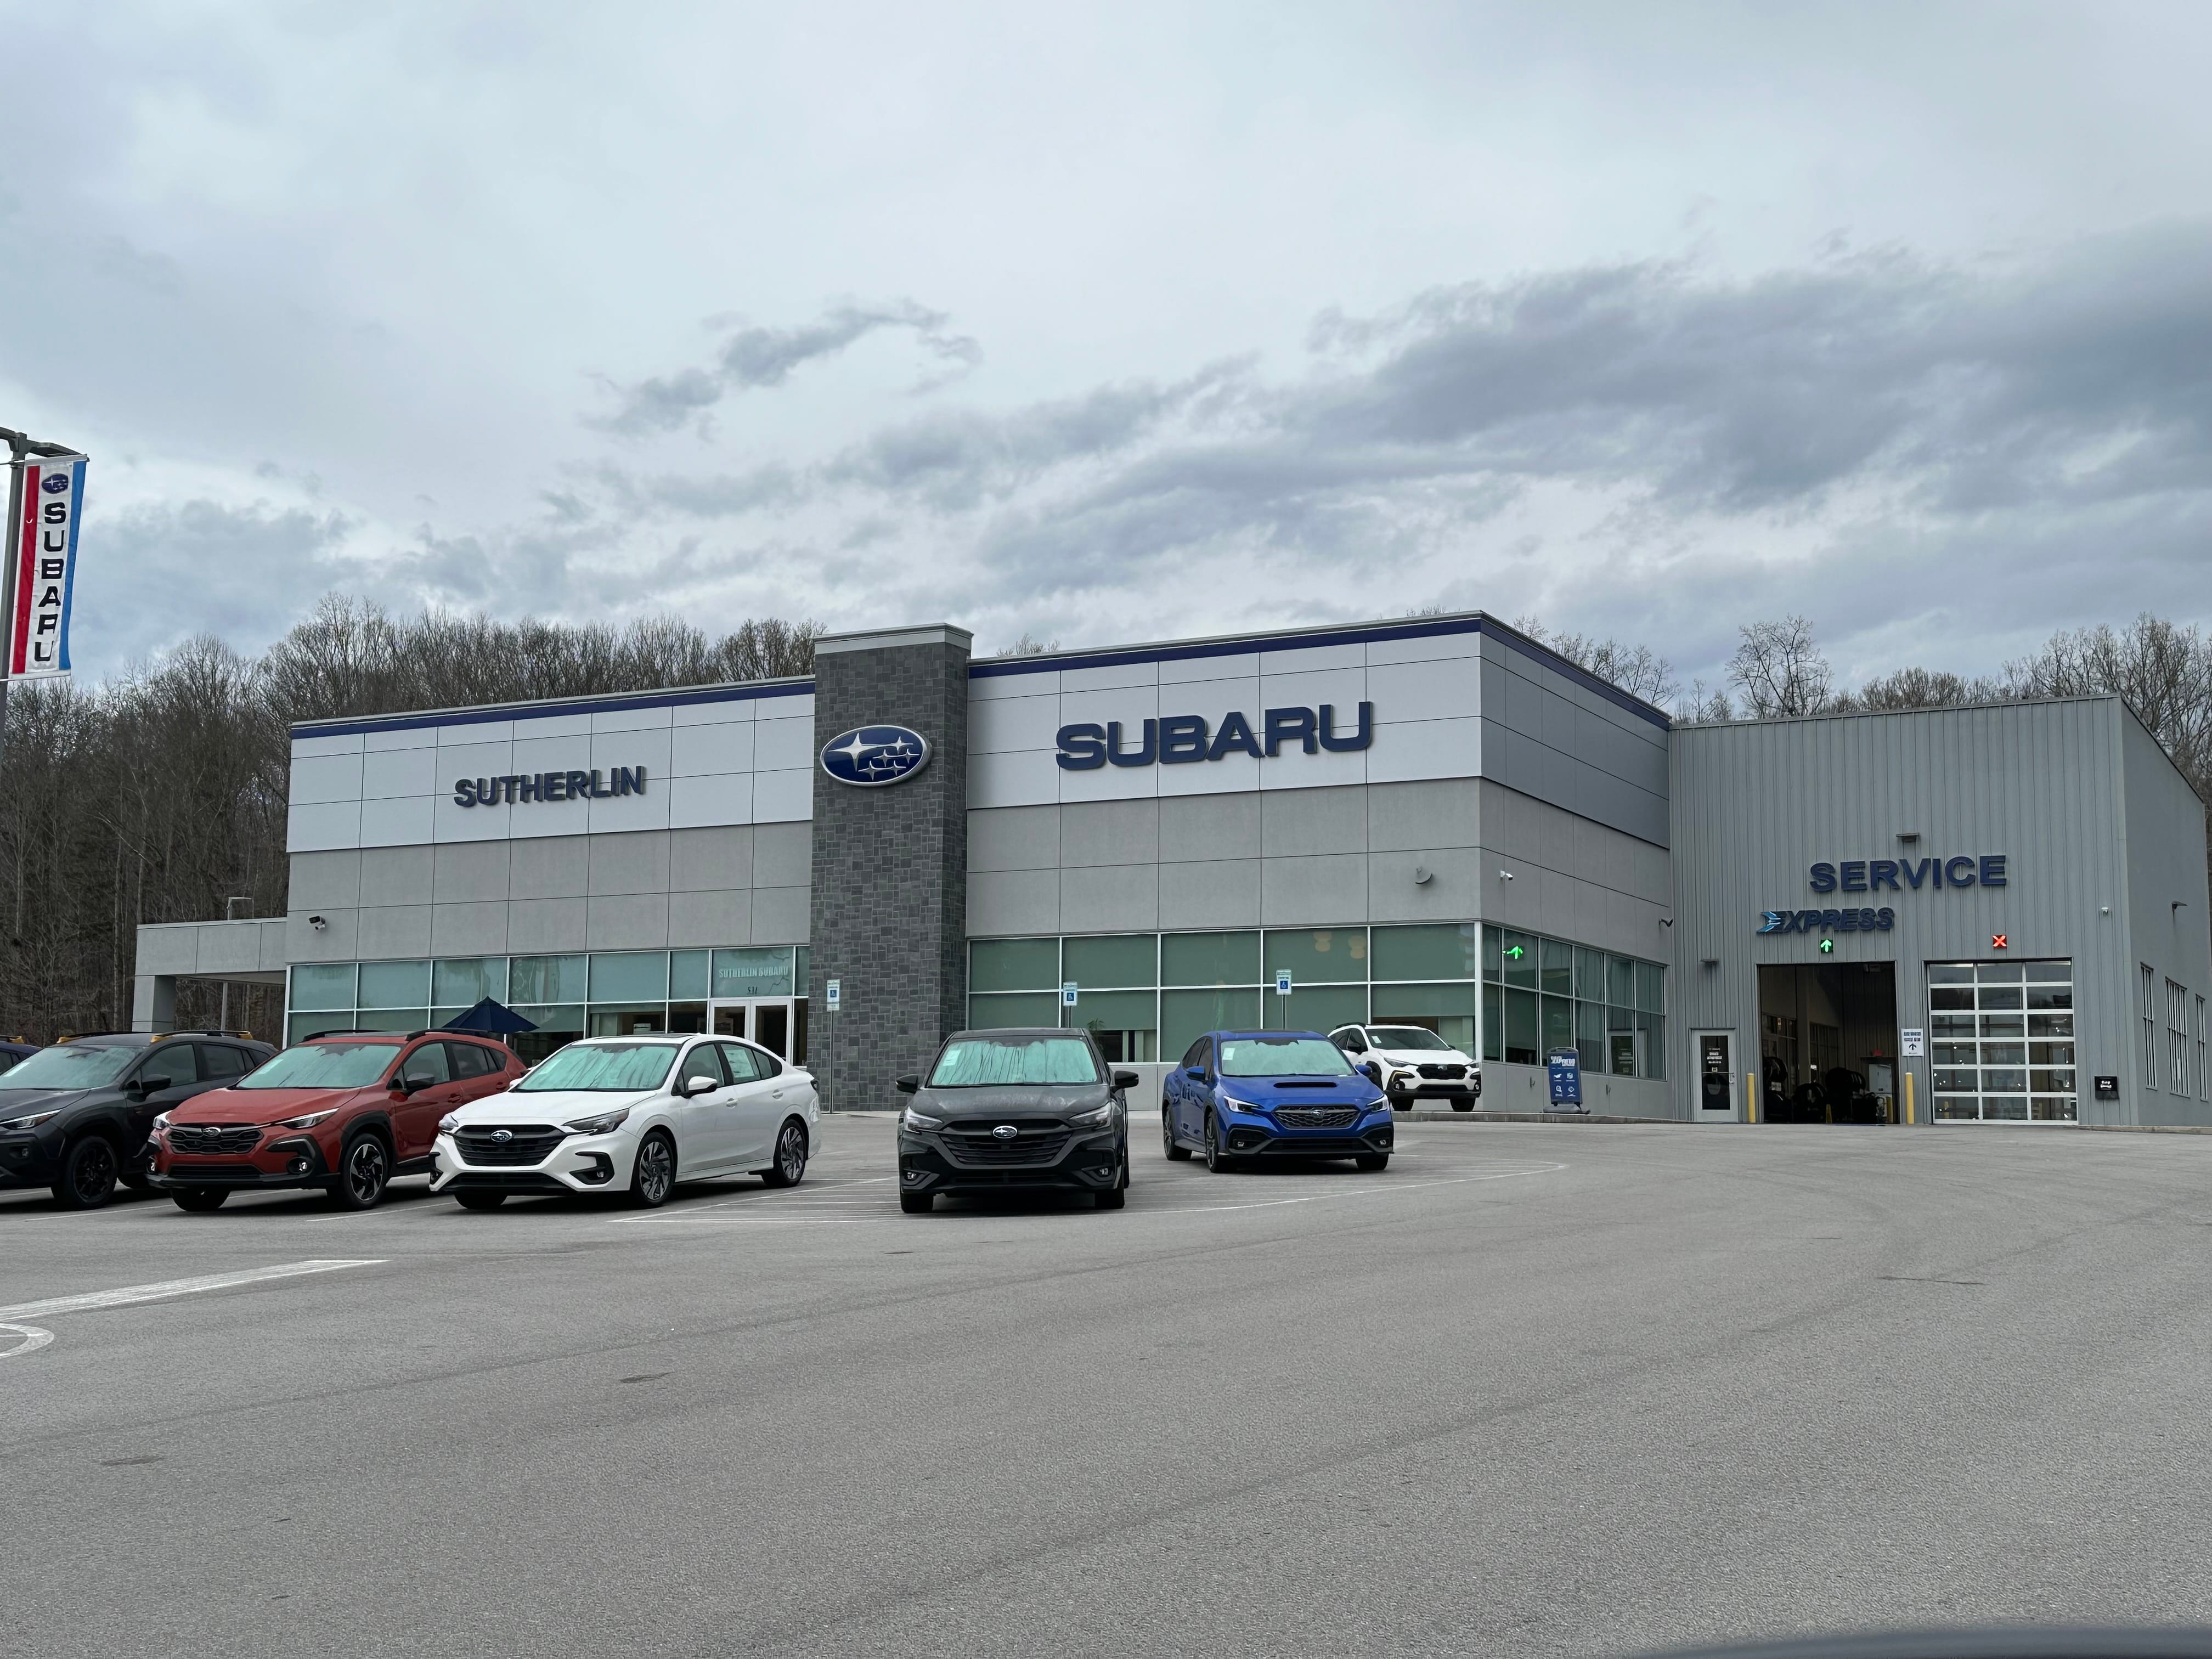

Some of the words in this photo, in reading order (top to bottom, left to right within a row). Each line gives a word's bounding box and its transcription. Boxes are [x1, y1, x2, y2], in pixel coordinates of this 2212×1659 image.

[34, 501, 66, 662] SUBARU
[1056, 701, 1373, 770] SUBARU
[454, 766, 647, 808] SUTHERLIN
[1810, 855, 2007, 892] SERVICE
[1757, 907, 1895, 933] EXPRESS
